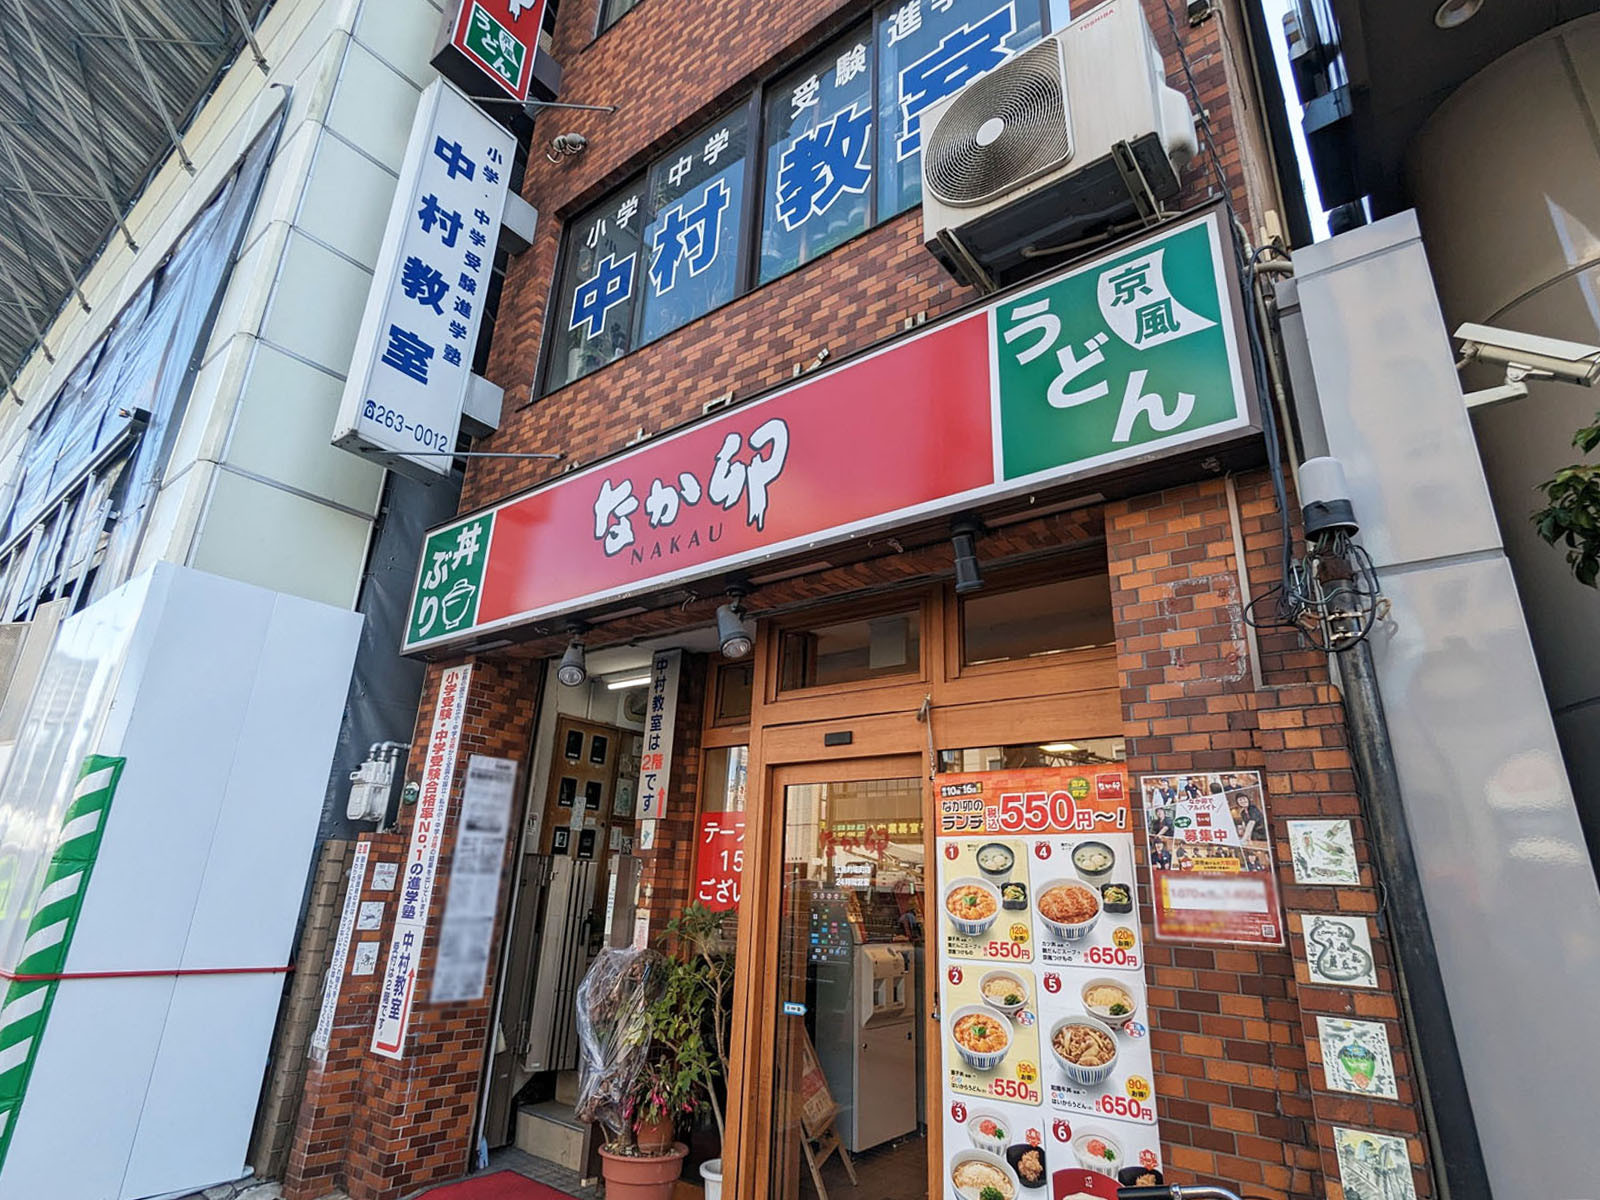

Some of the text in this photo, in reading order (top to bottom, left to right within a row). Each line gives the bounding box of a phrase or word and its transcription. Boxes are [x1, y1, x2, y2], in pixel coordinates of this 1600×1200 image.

[381, 135, 476, 386] 中村教室
[1107, 262, 1181, 345] 京風
[1003, 298, 1196, 443] うどん
[593, 417, 790, 557] なか卯
[630, 523, 725, 566] NAKAU
[943, 799, 984, 812] なか卯の
[943, 815, 984, 830] ランチ
[1184, 829, 1228, 842] 募集中
[988, 941, 1031, 960] 550円
[1089, 946, 1138, 967] 650円
[388, 931, 415, 1021] 中村教室
[994, 1078, 1039, 1102] 550円
[1101, 1094, 1153, 1121] 650円
